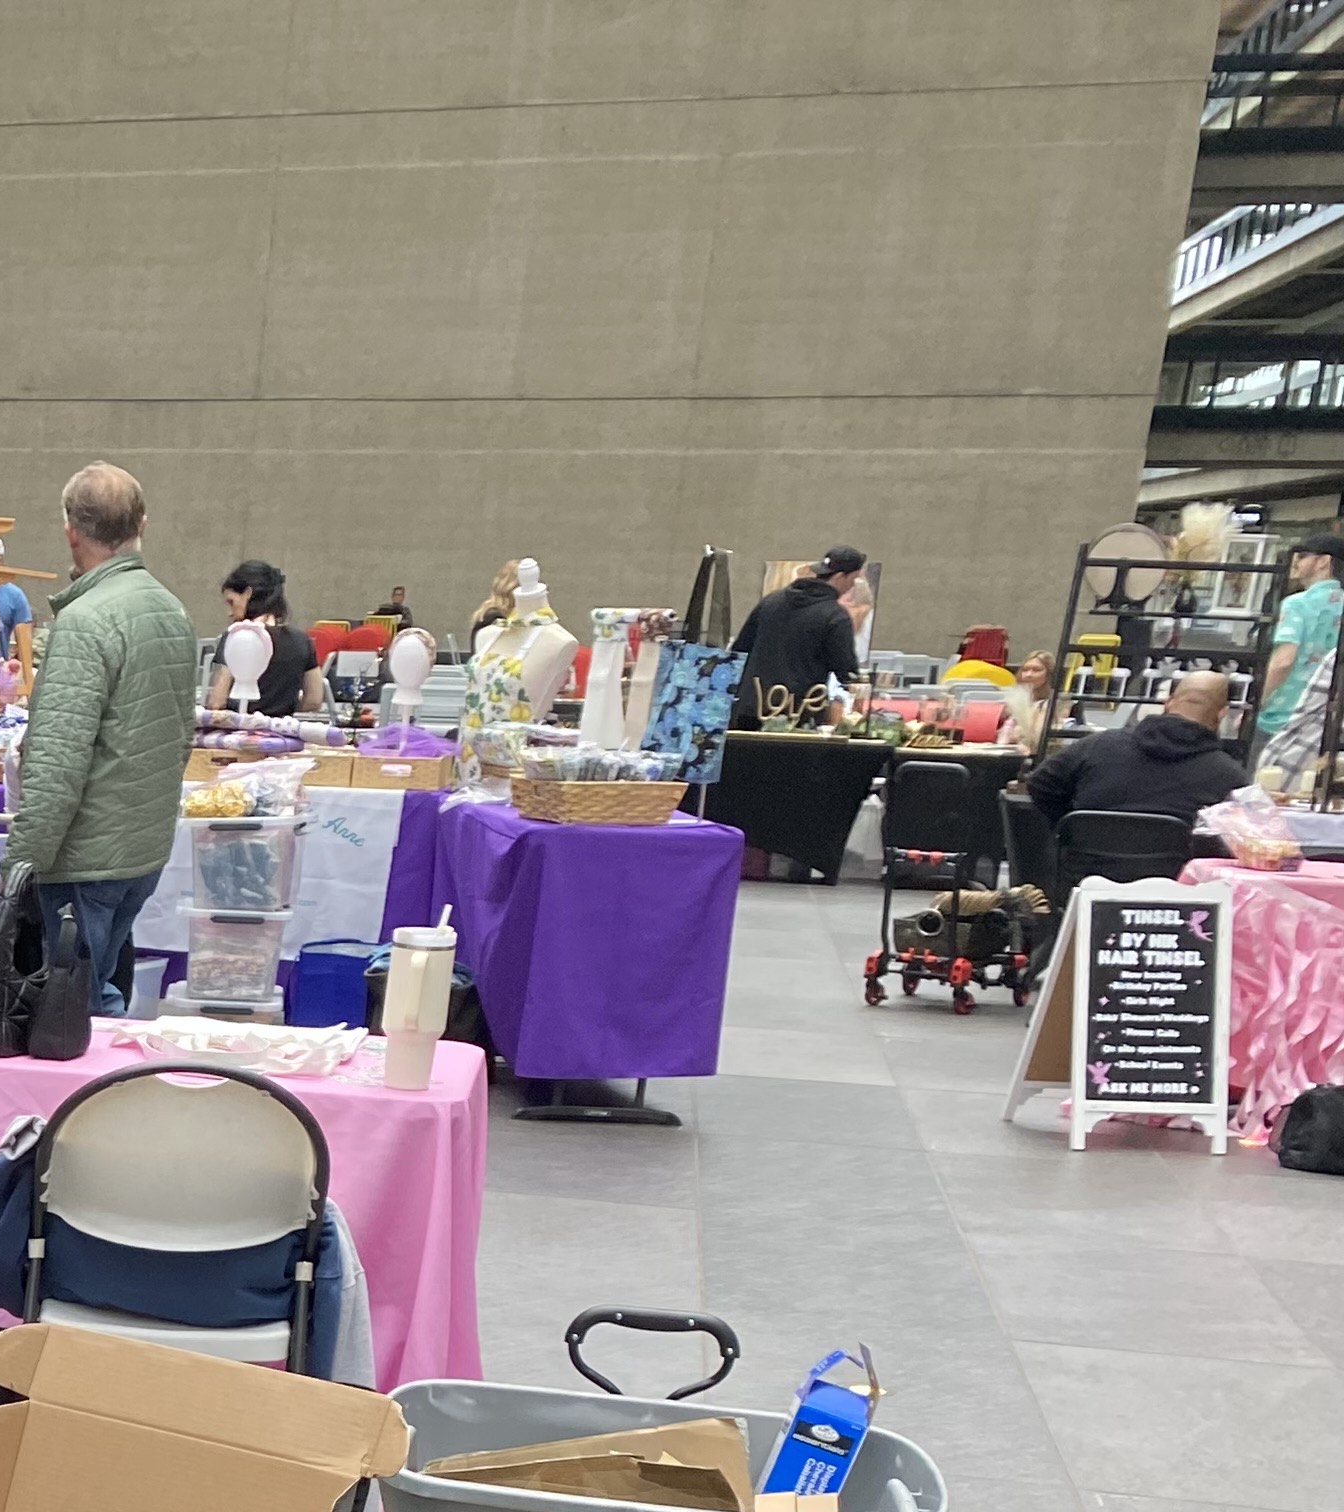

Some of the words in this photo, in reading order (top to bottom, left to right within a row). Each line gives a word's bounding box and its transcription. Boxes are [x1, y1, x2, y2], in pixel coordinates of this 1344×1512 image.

[322, 817, 365, 847] Anne
[1121, 910, 1185, 925] TINSEL
[1120, 933, 1145, 949] BY
[1098, 951, 1139, 966] HAIR
[1144, 951, 1206, 966] TINSEL
[1130, 1083, 1149, 1094] ME
[1152, 1083, 1188, 1094] MORE
